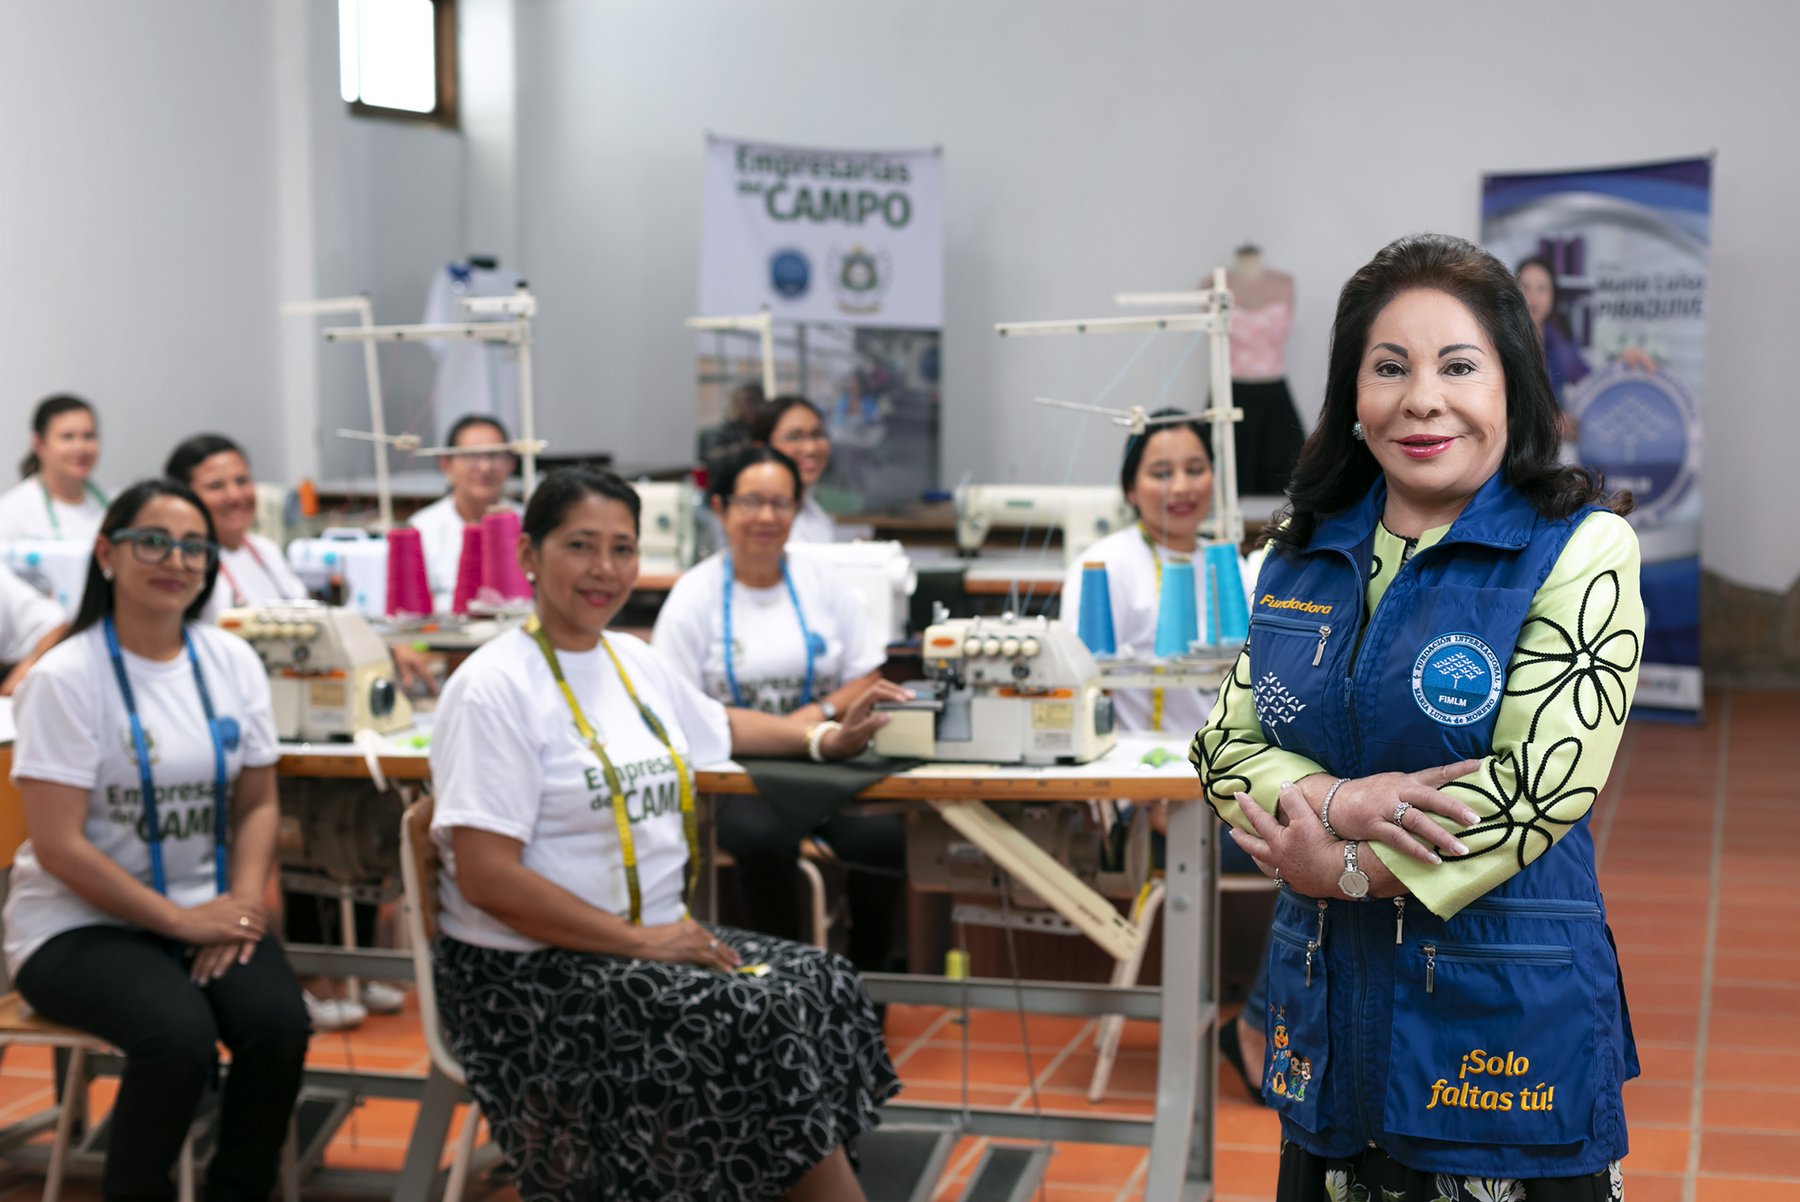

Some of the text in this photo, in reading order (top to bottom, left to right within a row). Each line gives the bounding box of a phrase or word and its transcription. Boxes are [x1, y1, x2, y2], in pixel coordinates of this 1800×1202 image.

[765, 182, 912, 229] CAMPO
[1260, 594, 1333, 614] Fundadora
[1455, 635, 1501, 683] INTERNACIONAL
[1429, 709, 1452, 723] LUISA
[1466, 698, 1495, 723] MORENO
[1438, 695, 1467, 707] FIMLM
[591, 781, 682, 823] de CAM
[1459, 1049, 1530, 1079] ¡Solo
[1426, 1078, 1555, 1111] faltas tú!
